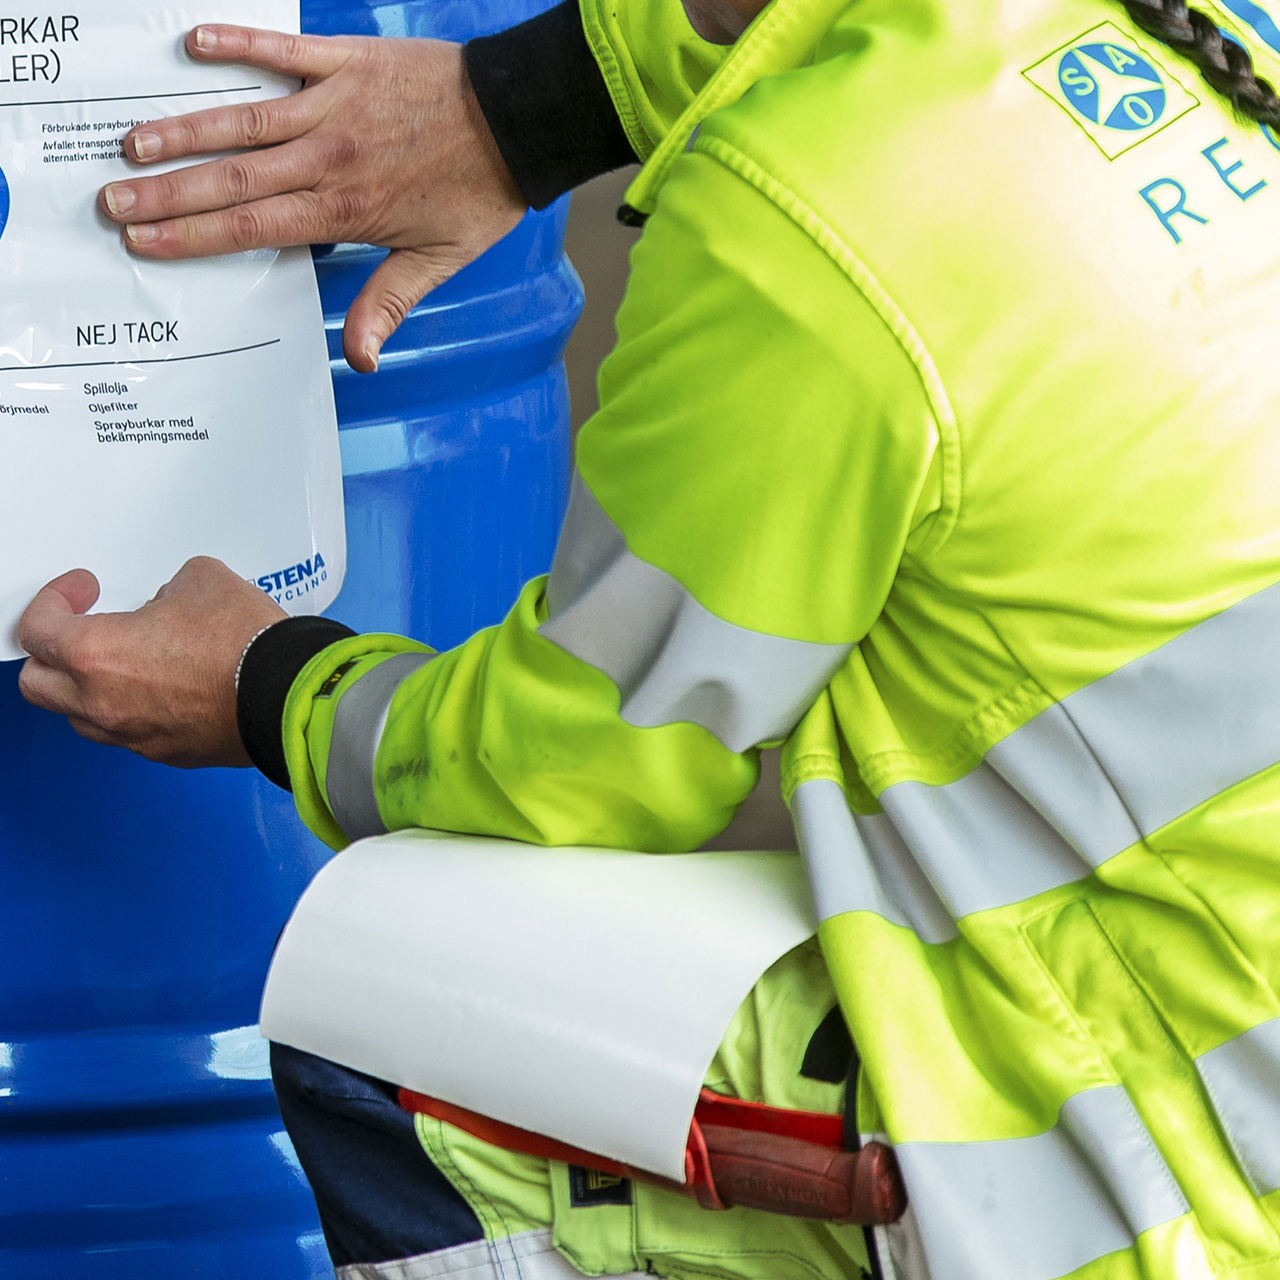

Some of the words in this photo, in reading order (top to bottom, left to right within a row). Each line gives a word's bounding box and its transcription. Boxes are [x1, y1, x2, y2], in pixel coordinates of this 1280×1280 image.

[42, 122, 91, 133] Förbrukade
[42, 140, 76, 150] Avfallet
[43, 152, 89, 164] alternativt
[91, 149, 127, 161] materia
[76, 323, 117, 347] NEJ
[123, 320, 179, 343] TACK
[83, 381, 128, 397] Spillolja
[88, 401, 139, 414] Oljefilter
[94, 417, 166, 432] Sprayburkar
[168, 416, 194, 427] med
[97, 429, 209, 444] bekämpningsmedel
[257, 552, 325, 593] STENA
